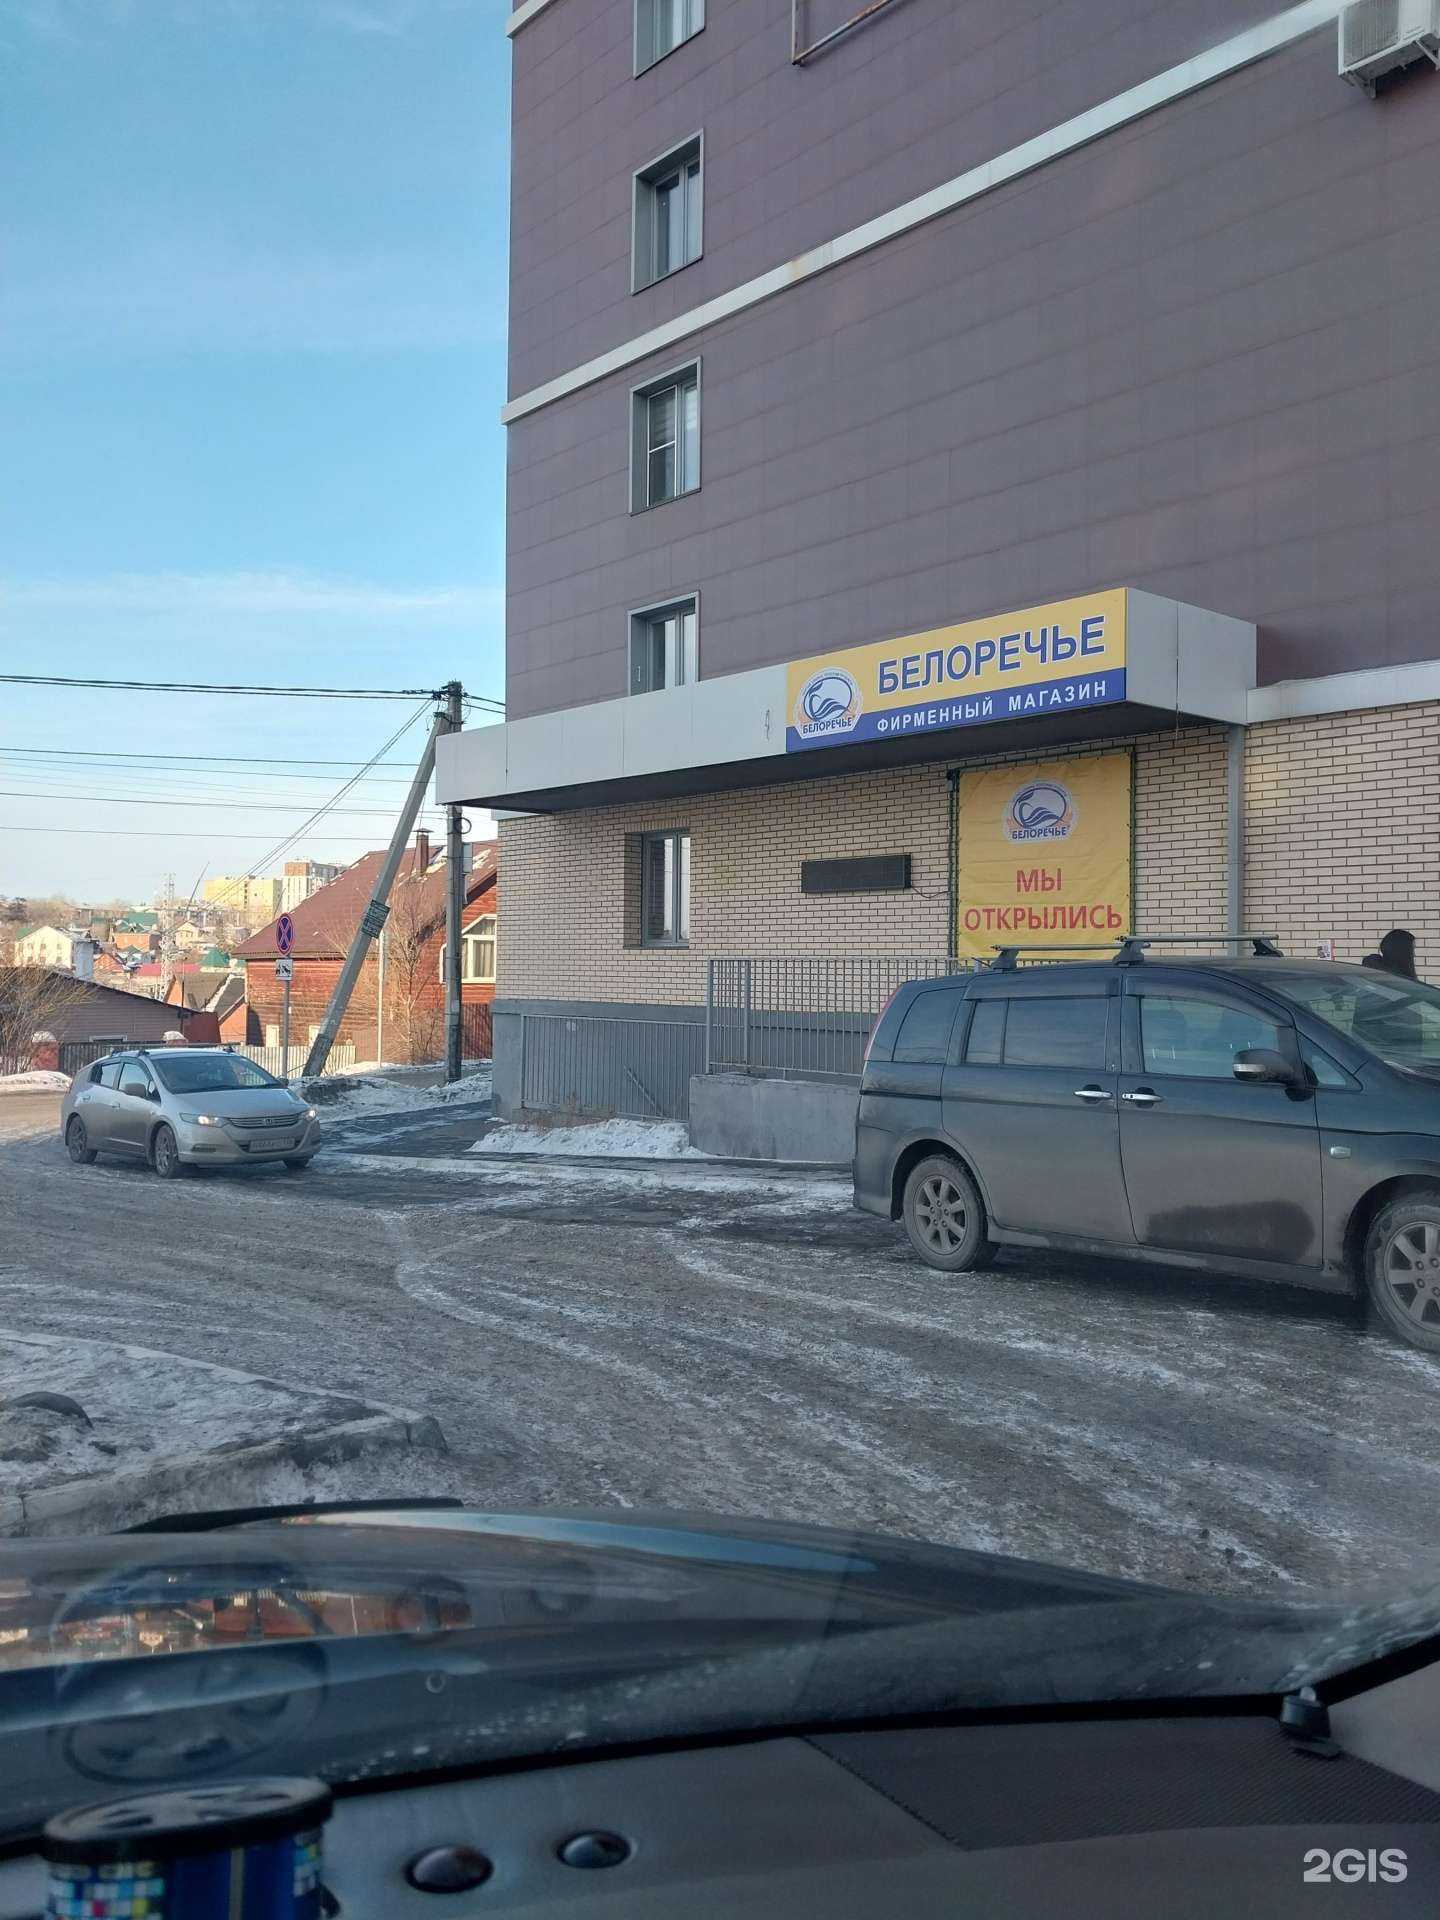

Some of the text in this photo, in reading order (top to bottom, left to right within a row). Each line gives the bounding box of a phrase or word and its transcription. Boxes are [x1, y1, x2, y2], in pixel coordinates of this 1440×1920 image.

[879, 616, 1106, 694] БЕЛОРЕЧЬЕ
[877, 680, 1106, 732] ФИРМЕННЫЙ МАГАЗИН
[1016, 868, 1062, 892] МЫ
[964, 905, 1123, 931] ОТКРЫЛИСЬ
